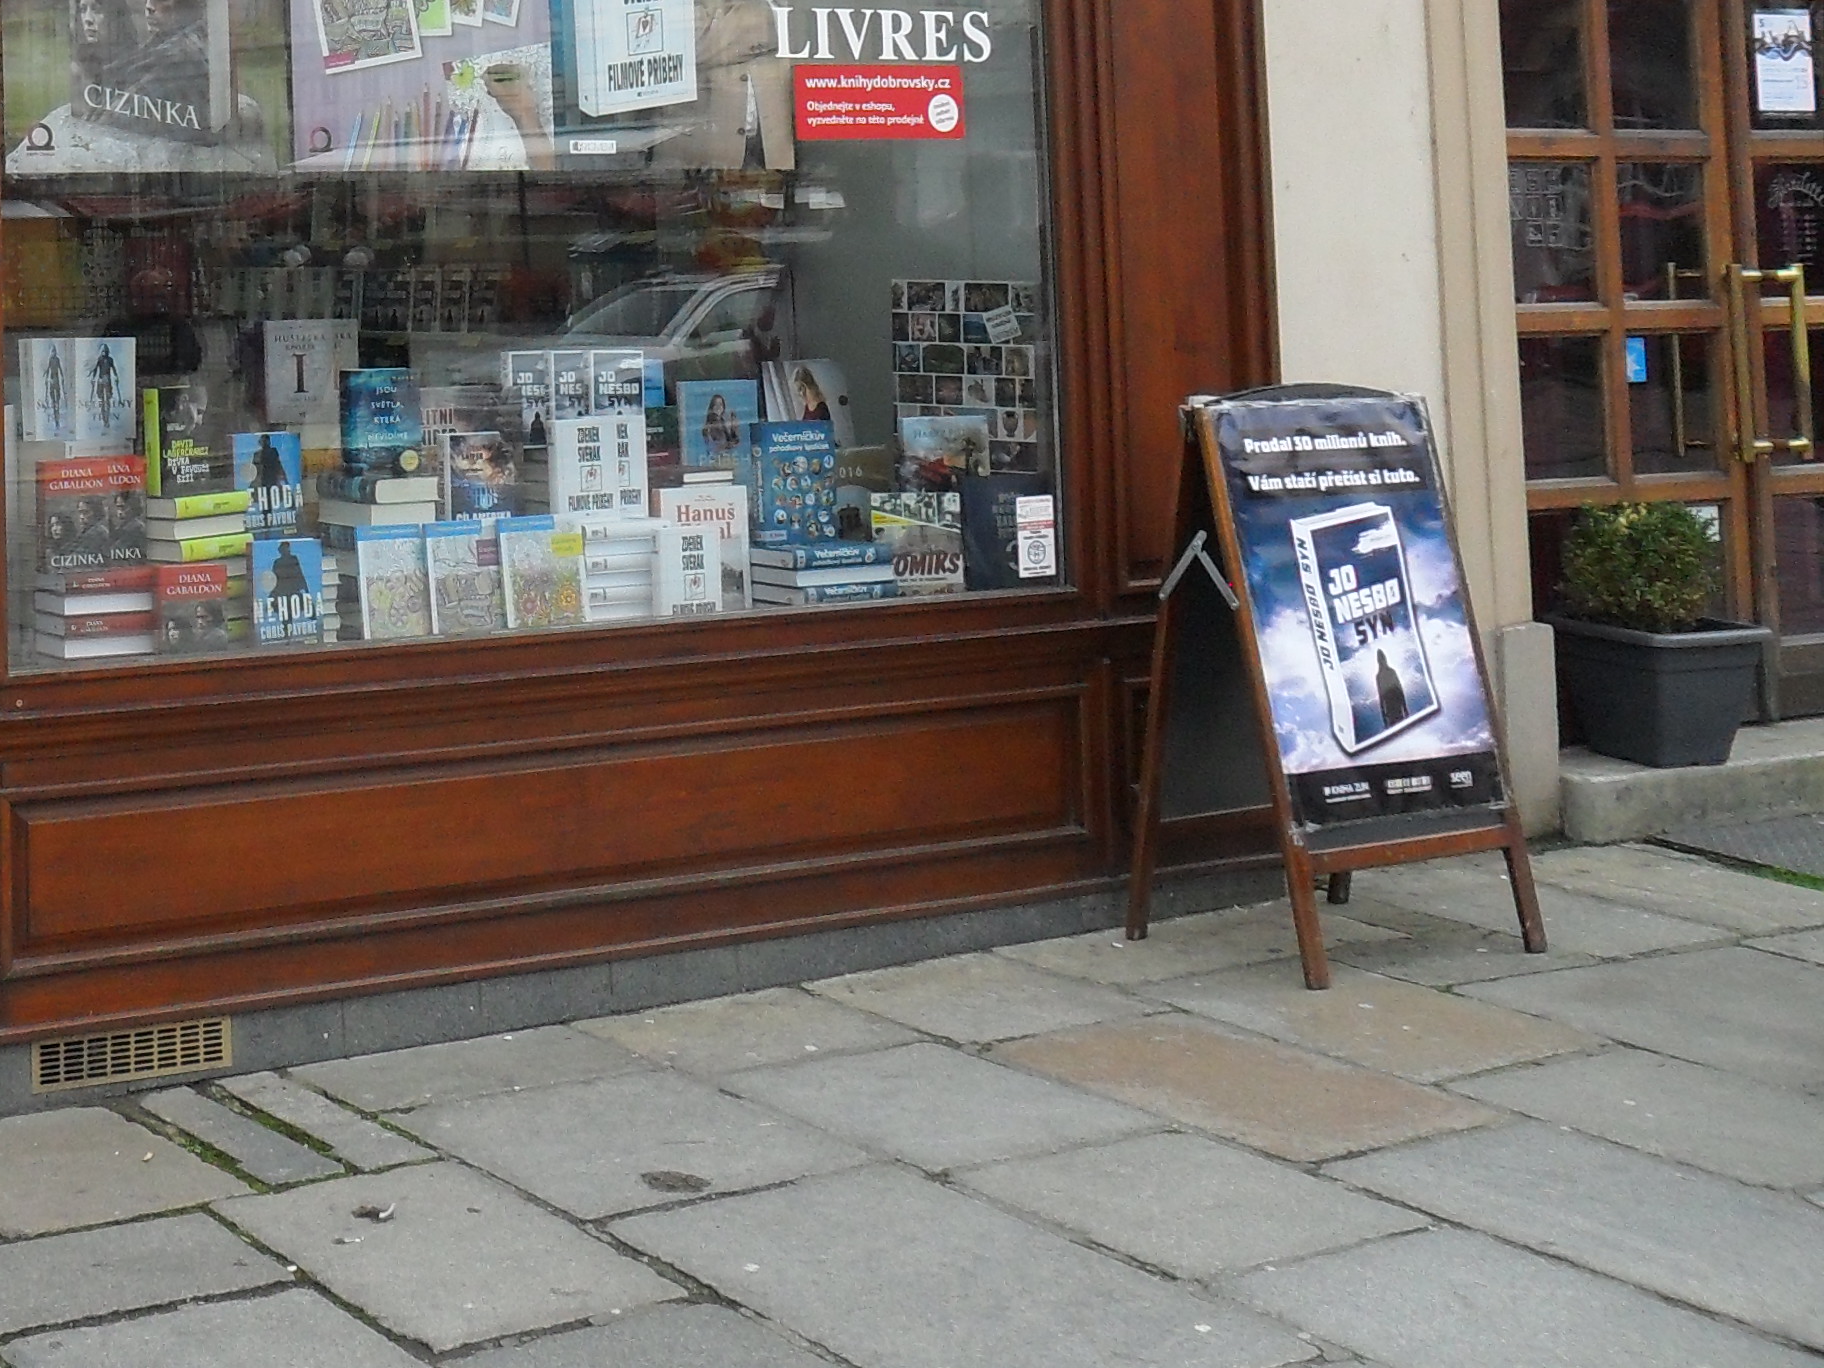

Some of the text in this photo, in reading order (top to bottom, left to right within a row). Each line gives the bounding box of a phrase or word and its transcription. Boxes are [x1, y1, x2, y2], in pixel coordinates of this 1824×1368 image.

[773, 6, 992, 63] LIVRES
[805, 74, 951, 92] www.knihydobrovsky.cz
[83, 83, 201, 130] CIZINKA
[598, 371, 616, 382] JO
[560, 384, 582, 394] NES
[1244, 436, 1293, 454] Prodal
[1293, 435, 1313, 451] 30
[61, 468, 93, 478] DIANA
[839, 466, 863, 479] 016
[1247, 474, 1283, 492] Vám
[1285, 471, 1317, 489] stačí
[1318, 470, 1367, 492] přečíst
[1368, 469, 1383, 484] si
[248, 484, 304, 512] EHODA
[677, 503, 735, 522] Hanuš
[51, 553, 104, 567] CIZINKA
[110, 547, 142, 560] INKA
[893, 552, 961, 577] OMIKS
[179, 574, 211, 584] DIANA
[1328, 564, 1357, 596] JO
[166, 584, 223, 595] GABALDON
[253, 592, 325, 624] NEHODA
[1354, 610, 1394, 646] SYN
